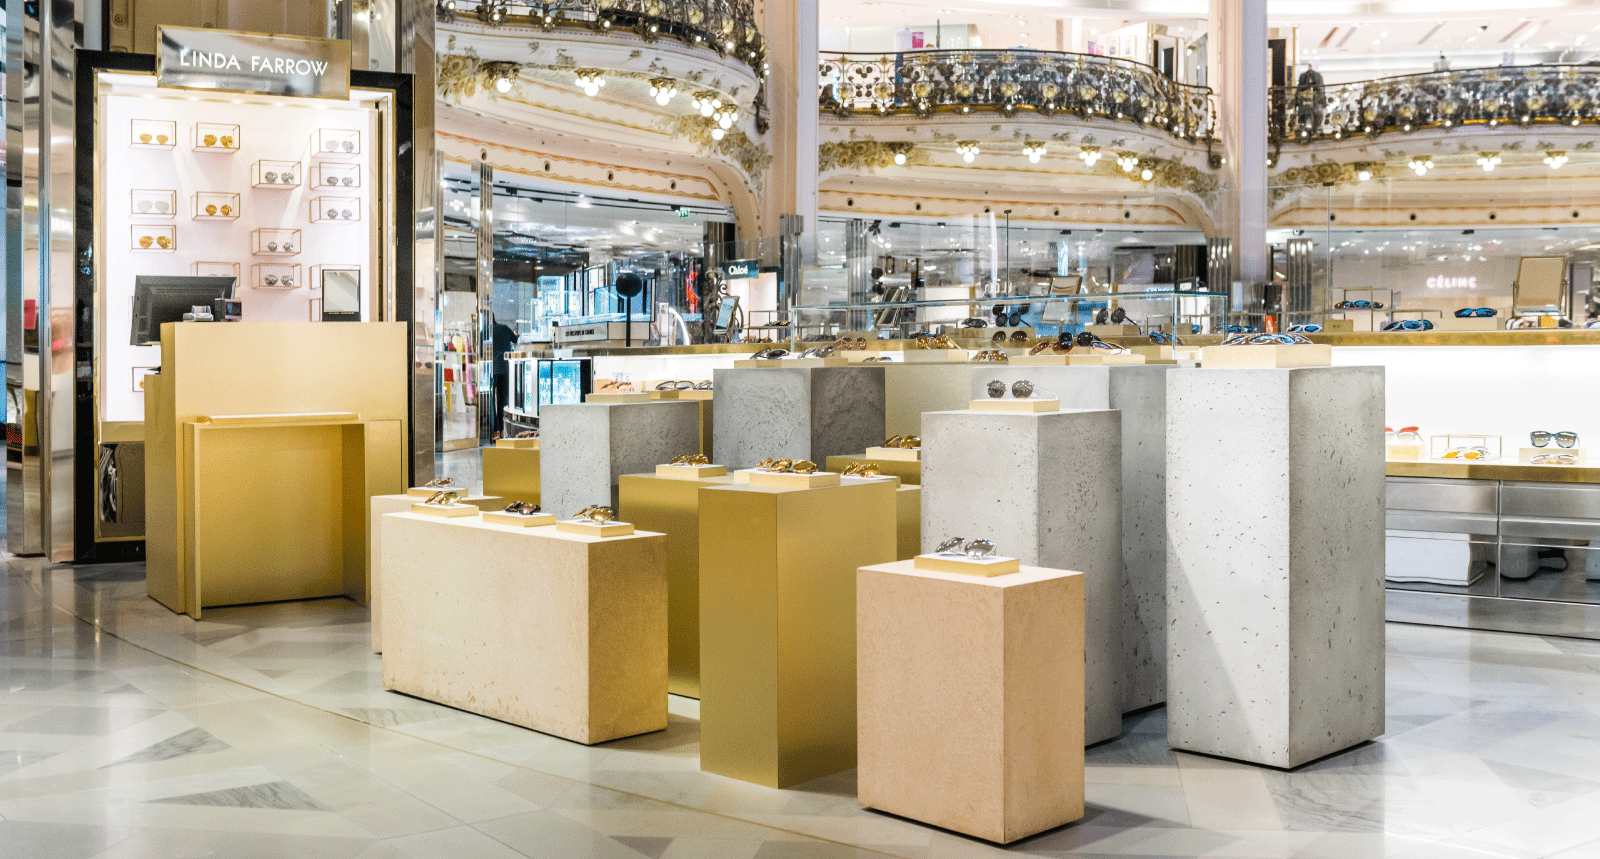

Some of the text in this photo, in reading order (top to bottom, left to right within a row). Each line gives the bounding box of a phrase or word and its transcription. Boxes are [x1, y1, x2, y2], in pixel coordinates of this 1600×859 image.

[180, 50, 329, 77] LINDA FARROW
[1426, 274, 1477, 289] CÉLINE
